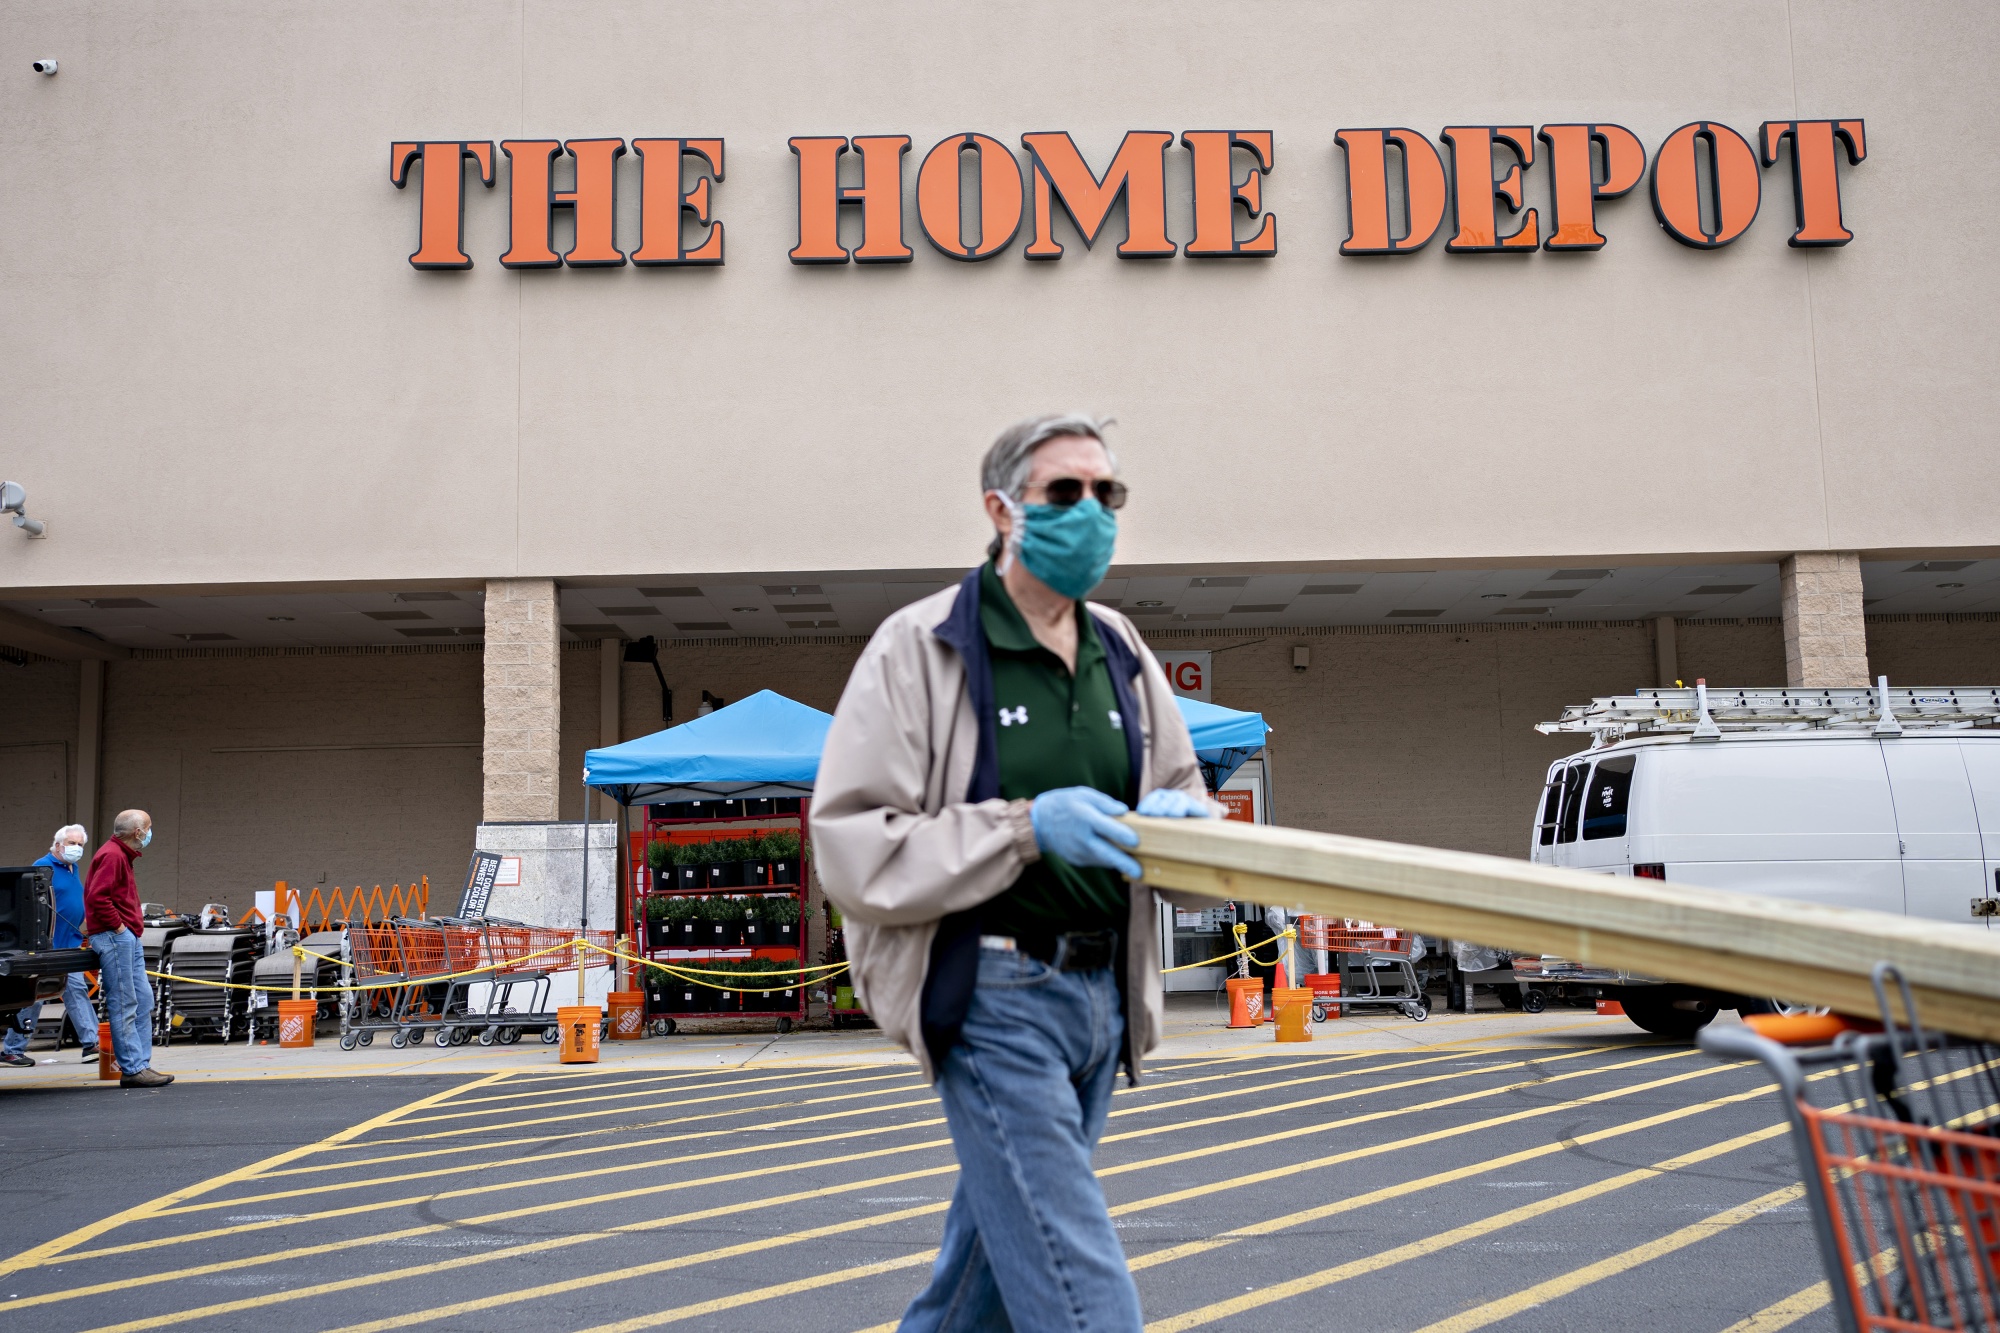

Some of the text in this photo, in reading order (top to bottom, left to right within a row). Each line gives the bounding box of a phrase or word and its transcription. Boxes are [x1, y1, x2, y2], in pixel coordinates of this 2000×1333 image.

[390, 118, 1868, 270] THE HOME DEPOT
[475, 858, 490, 886] NEWEST
[467, 886, 481, 910] COLOR
[475, 859, 498, 917] BEST COUNTERTO
[282, 1019, 290, 1028] THE
[618, 1007, 641, 1032] HOME
[620, 1010, 631, 1020] THE
[280, 1015, 303, 1041] HOME
[287, 1025, 303, 1041] DEPOT
